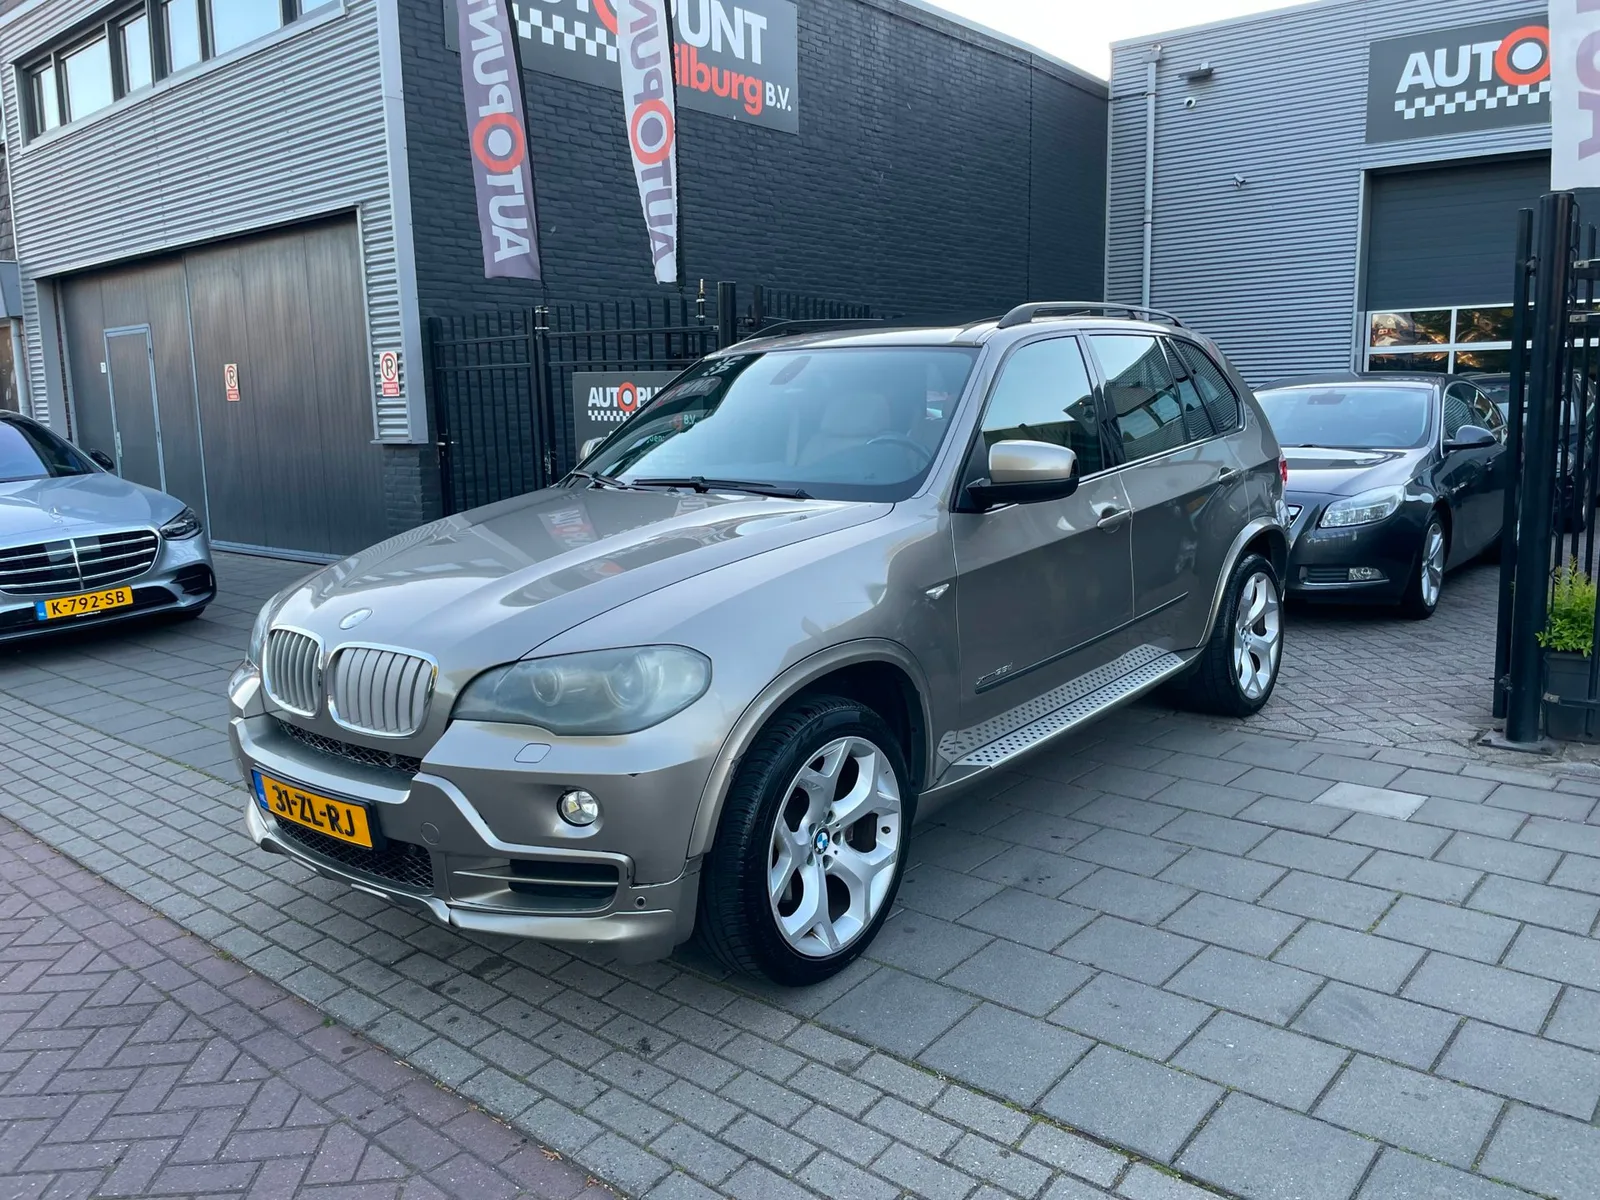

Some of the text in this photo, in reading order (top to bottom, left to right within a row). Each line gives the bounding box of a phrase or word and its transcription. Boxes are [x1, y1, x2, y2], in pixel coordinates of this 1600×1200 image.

[673, 43, 792, 116] ilburg B.V.
[1395, 25, 1551, 94] AUTO
[52, 590, 125, 615] K-792-SB
[272, 784, 355, 837] 31-ZL-RJ
